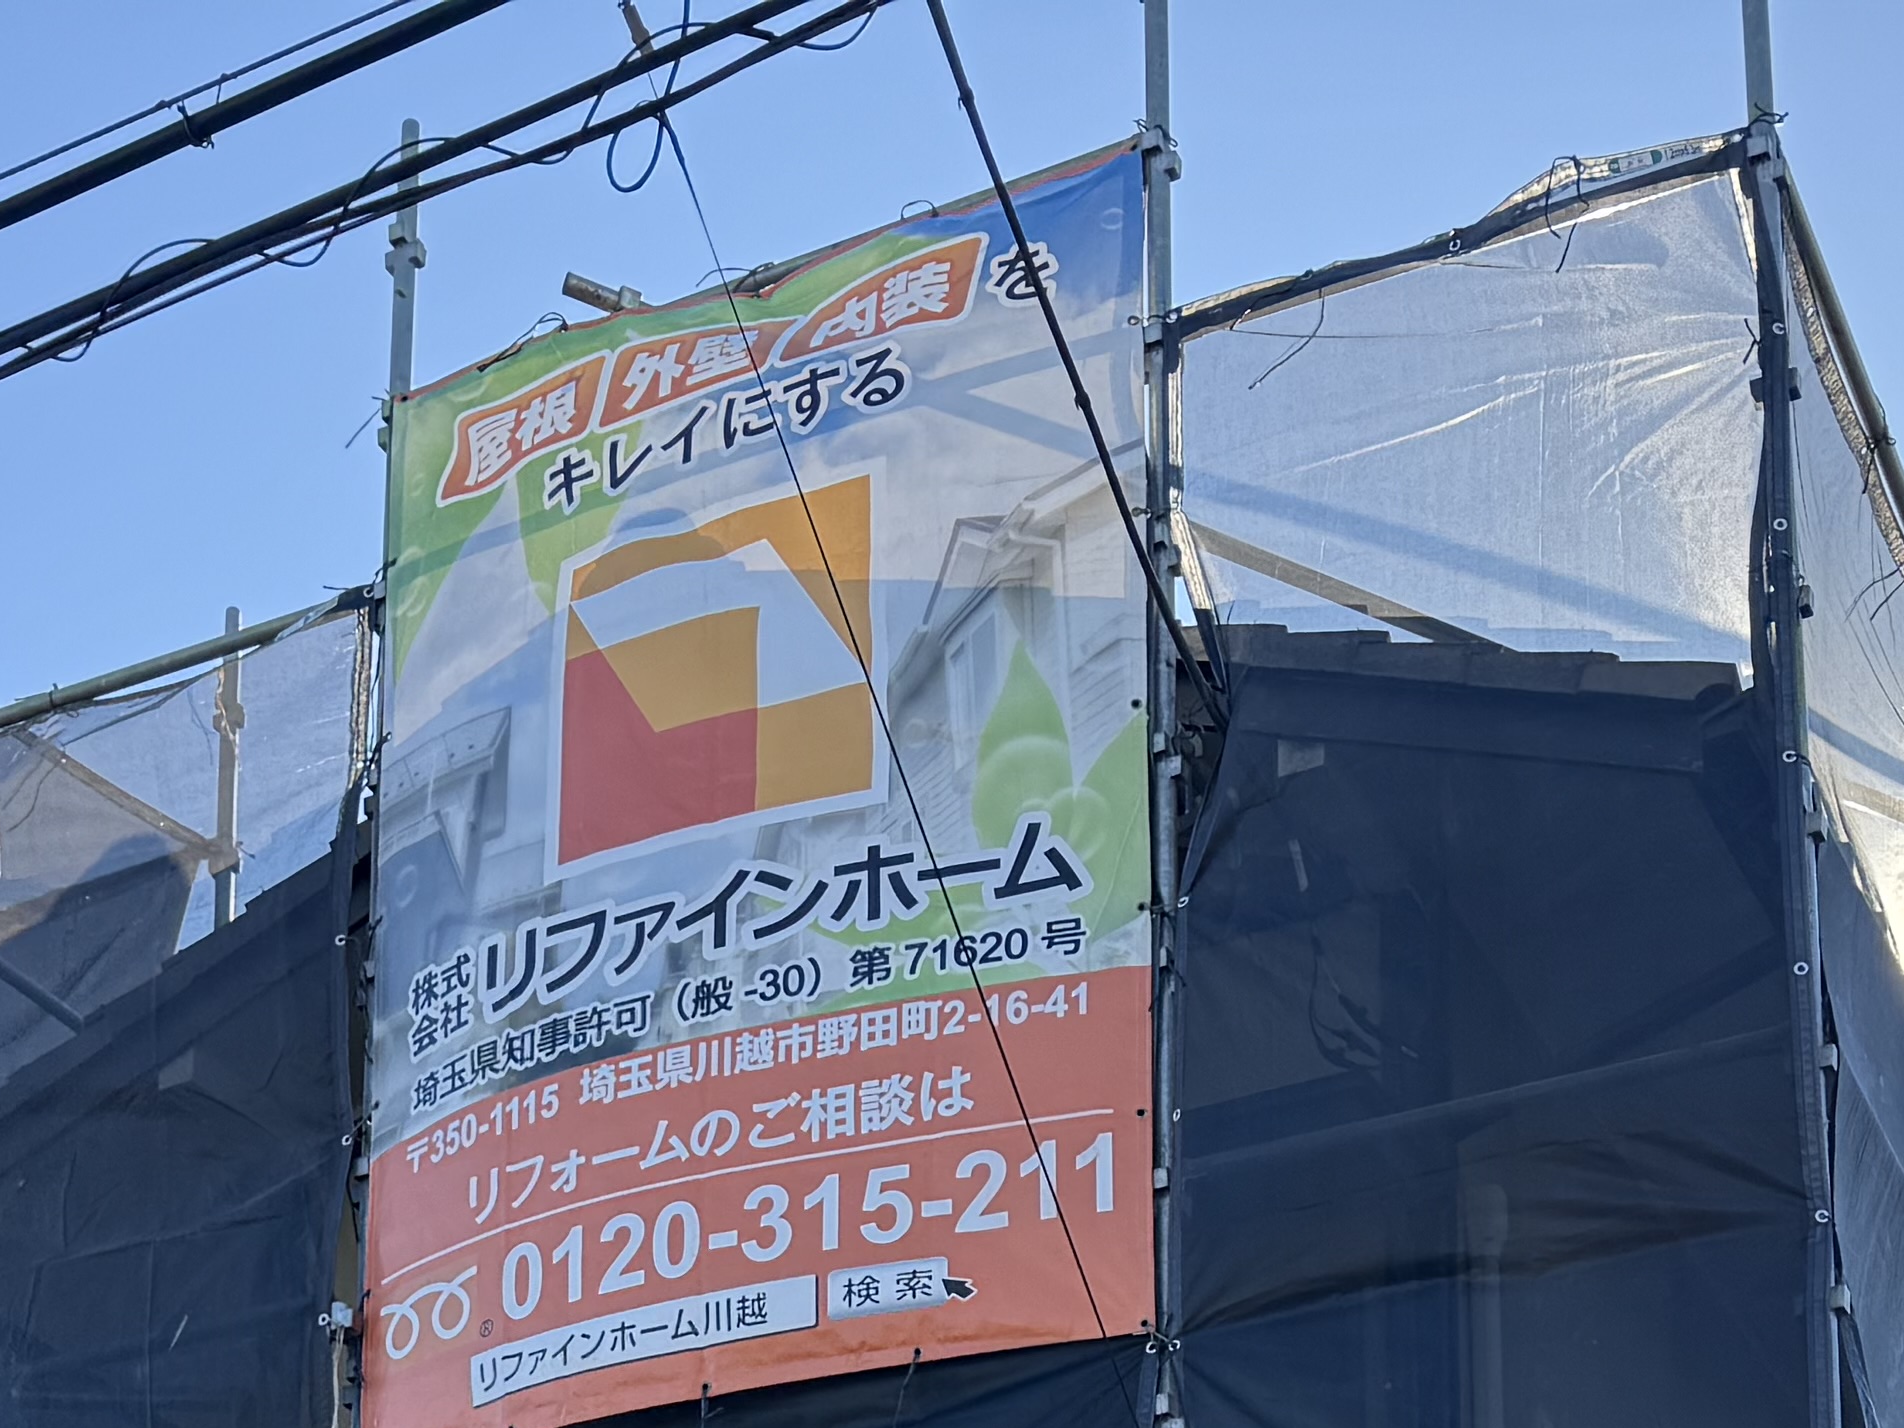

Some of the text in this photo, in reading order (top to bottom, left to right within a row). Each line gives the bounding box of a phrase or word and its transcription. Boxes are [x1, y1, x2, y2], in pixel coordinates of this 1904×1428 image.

[465, 248, 1051, 486] 屋根 外壁 内装 を
[547, 347, 905, 507] キレイにする
[486, 822, 1084, 1014] リファインホーム
[579, 981, 1089, 1105] 埼玉県川越市野田町2-16-41
[468, 1065, 974, 1225] リフォームのご相談は
[501, 1131, 1115, 1321] 0120-315-211
[479, 1292, 769, 1392] リファインホーム川越
